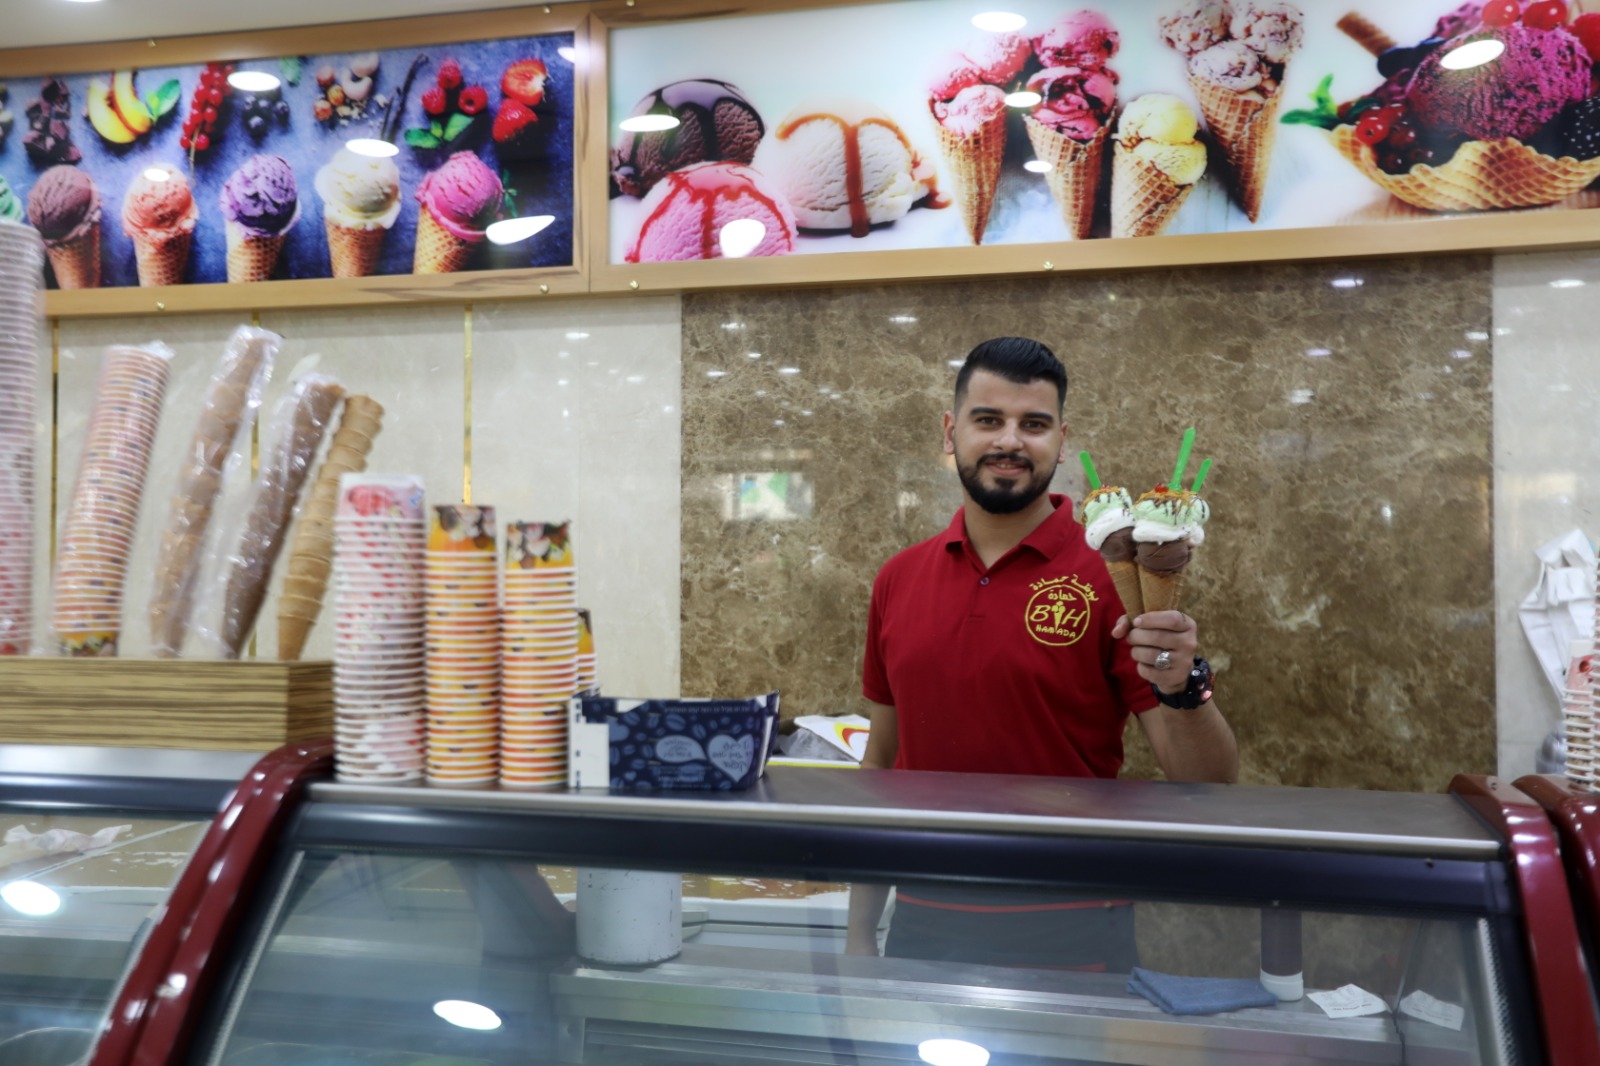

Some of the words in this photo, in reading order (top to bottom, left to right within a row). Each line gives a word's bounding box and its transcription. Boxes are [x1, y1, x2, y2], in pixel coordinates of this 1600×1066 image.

[1029, 575, 1069, 591] حمادة
[1048, 589, 1077, 601] حمادة
[1029, 604, 1052, 622] B
[1061, 608, 1088, 628] H
[1035, 624, 1076, 639] HAMADA
